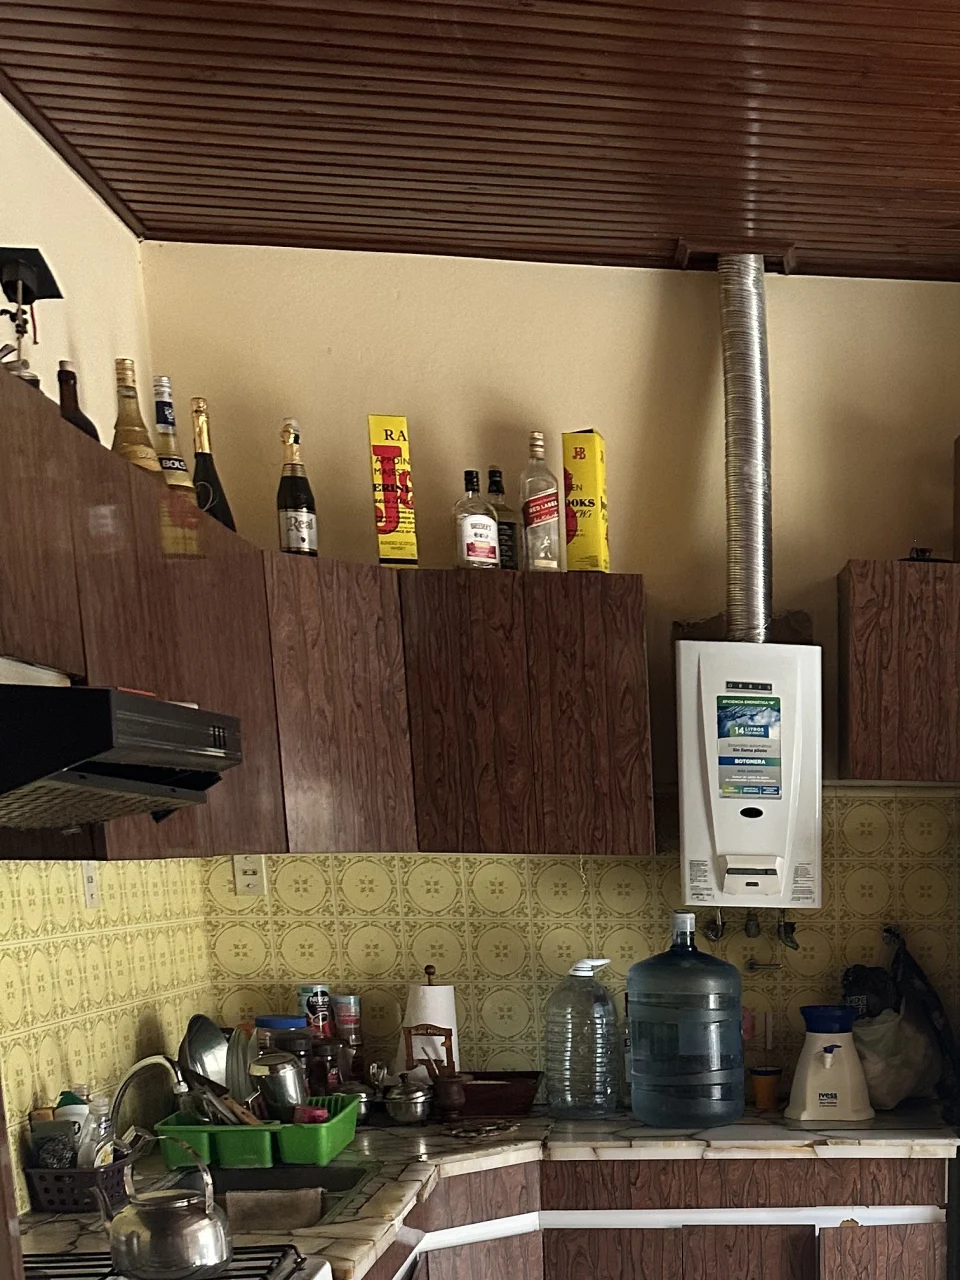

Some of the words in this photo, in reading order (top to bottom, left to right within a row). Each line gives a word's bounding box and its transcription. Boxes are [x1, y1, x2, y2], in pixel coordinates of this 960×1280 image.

[540, 500, 558, 510] LABEL
[287, 516, 313, 532] Real
[734, 726, 745, 735] 14
